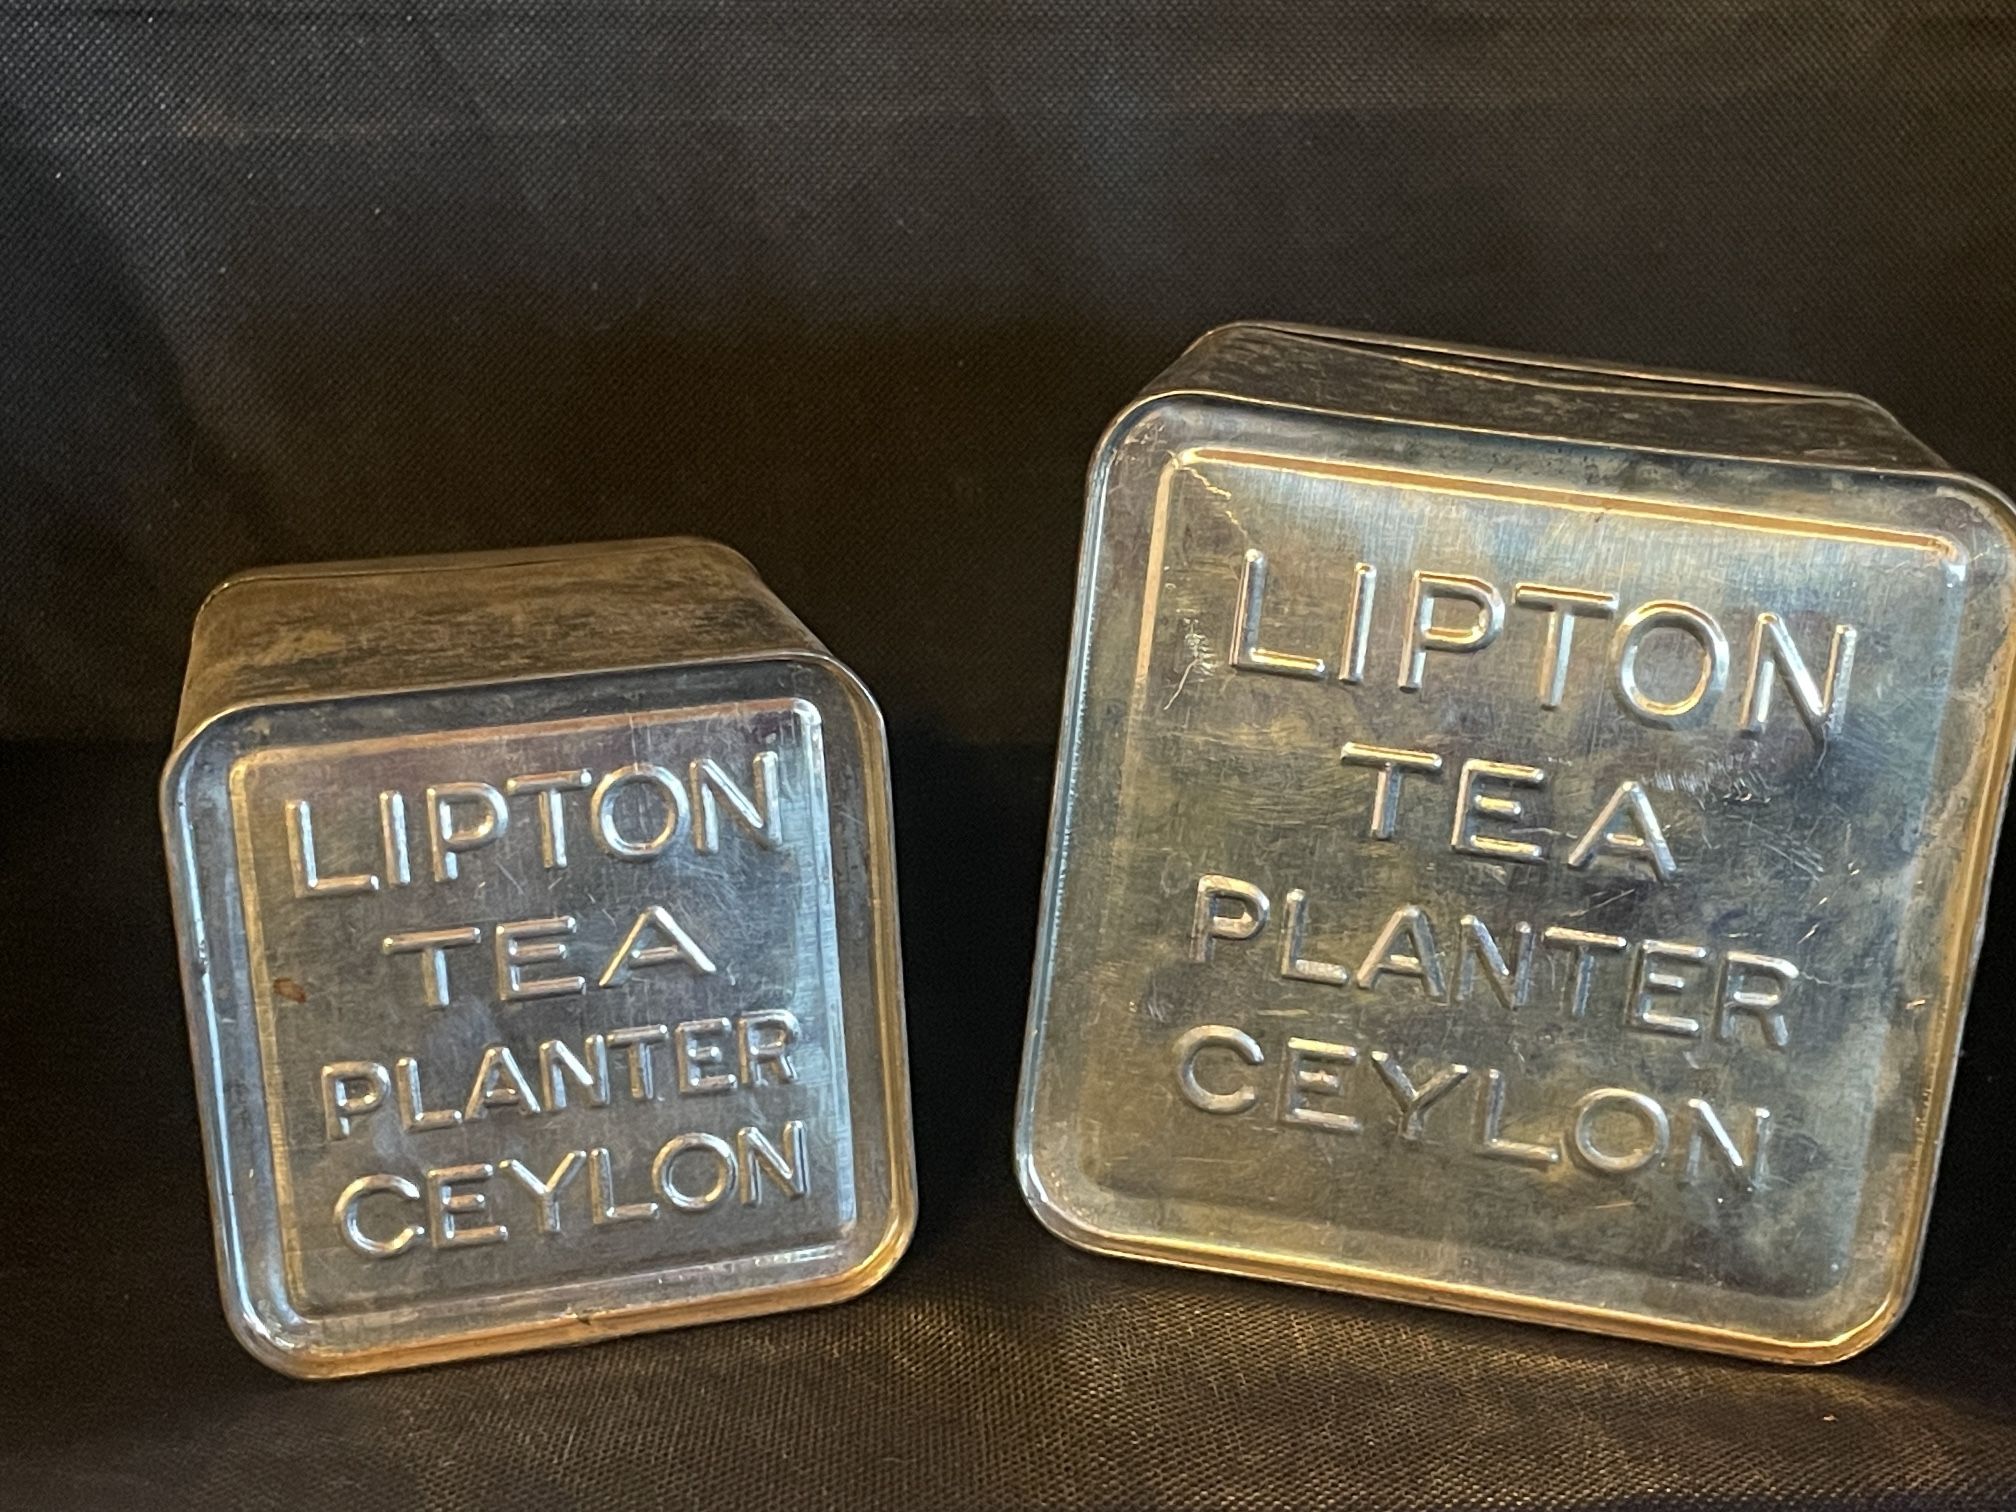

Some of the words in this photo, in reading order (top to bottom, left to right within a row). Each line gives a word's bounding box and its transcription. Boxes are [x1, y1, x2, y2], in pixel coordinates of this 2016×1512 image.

[1229, 548, 1857, 742] LIPTON
[286, 751, 783, 898] LIPTON
[1340, 742, 1678, 880] TEA
[382, 906, 717, 1006] TEA
[1190, 874, 1799, 1048] PLANTER
[320, 1008, 800, 1140] PLANTER
[1173, 1024, 1771, 1192] CEYLON
[334, 1121, 808, 1257] CEYLON
